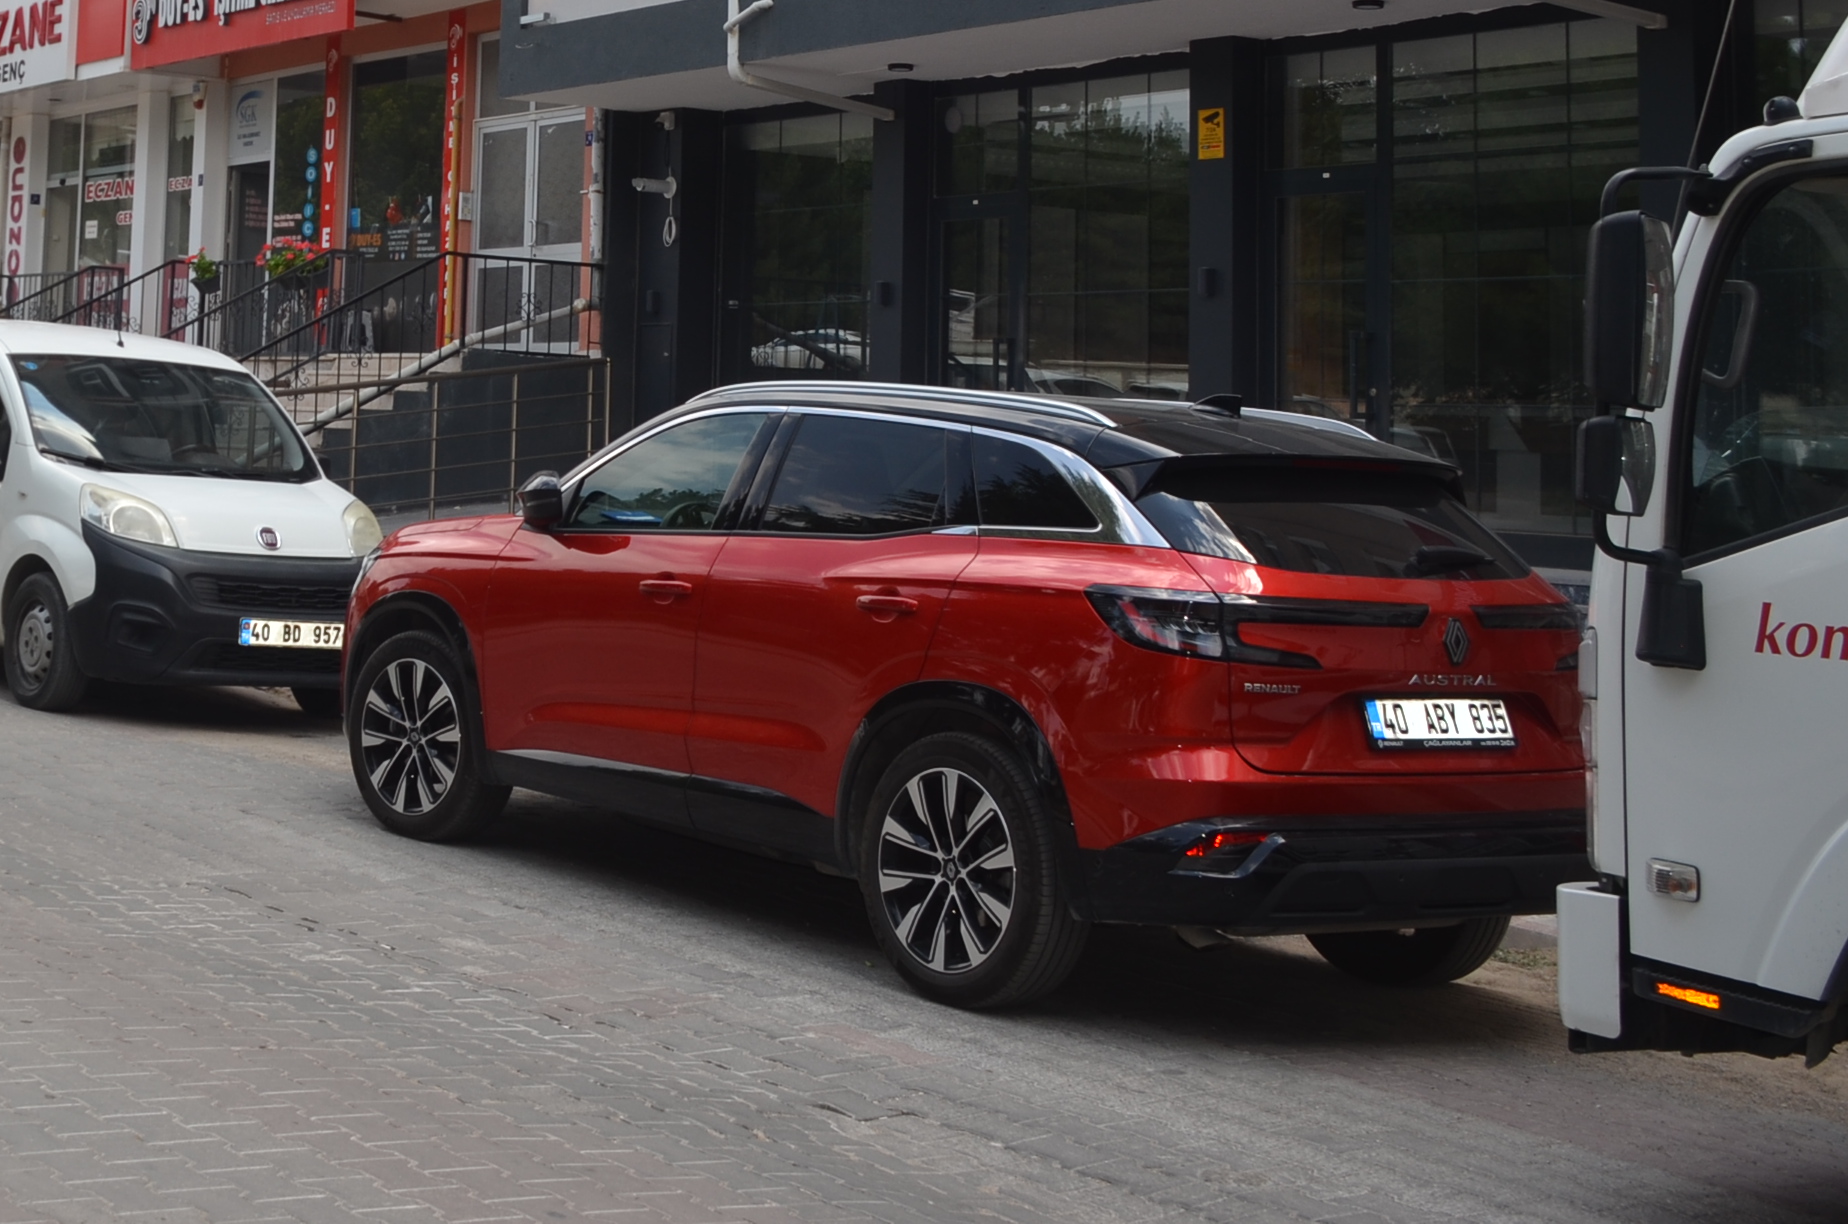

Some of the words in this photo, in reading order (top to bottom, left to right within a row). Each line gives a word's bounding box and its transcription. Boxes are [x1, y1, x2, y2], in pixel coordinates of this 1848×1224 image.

[85, 178, 135, 203] ECZAN
[168, 176, 193, 192] ECZA
[251, 622, 271, 642] 40
[282, 623, 302, 643] BD
[313, 625, 342, 645] 957
[1243, 682, 1302, 695] RENAULT
[1408, 674, 1497, 687] AUSTRAL
[1382, 703, 1409, 735] 40
[1423, 702, 1460, 735] ABY
[1468, 703, 1510, 735] 835
